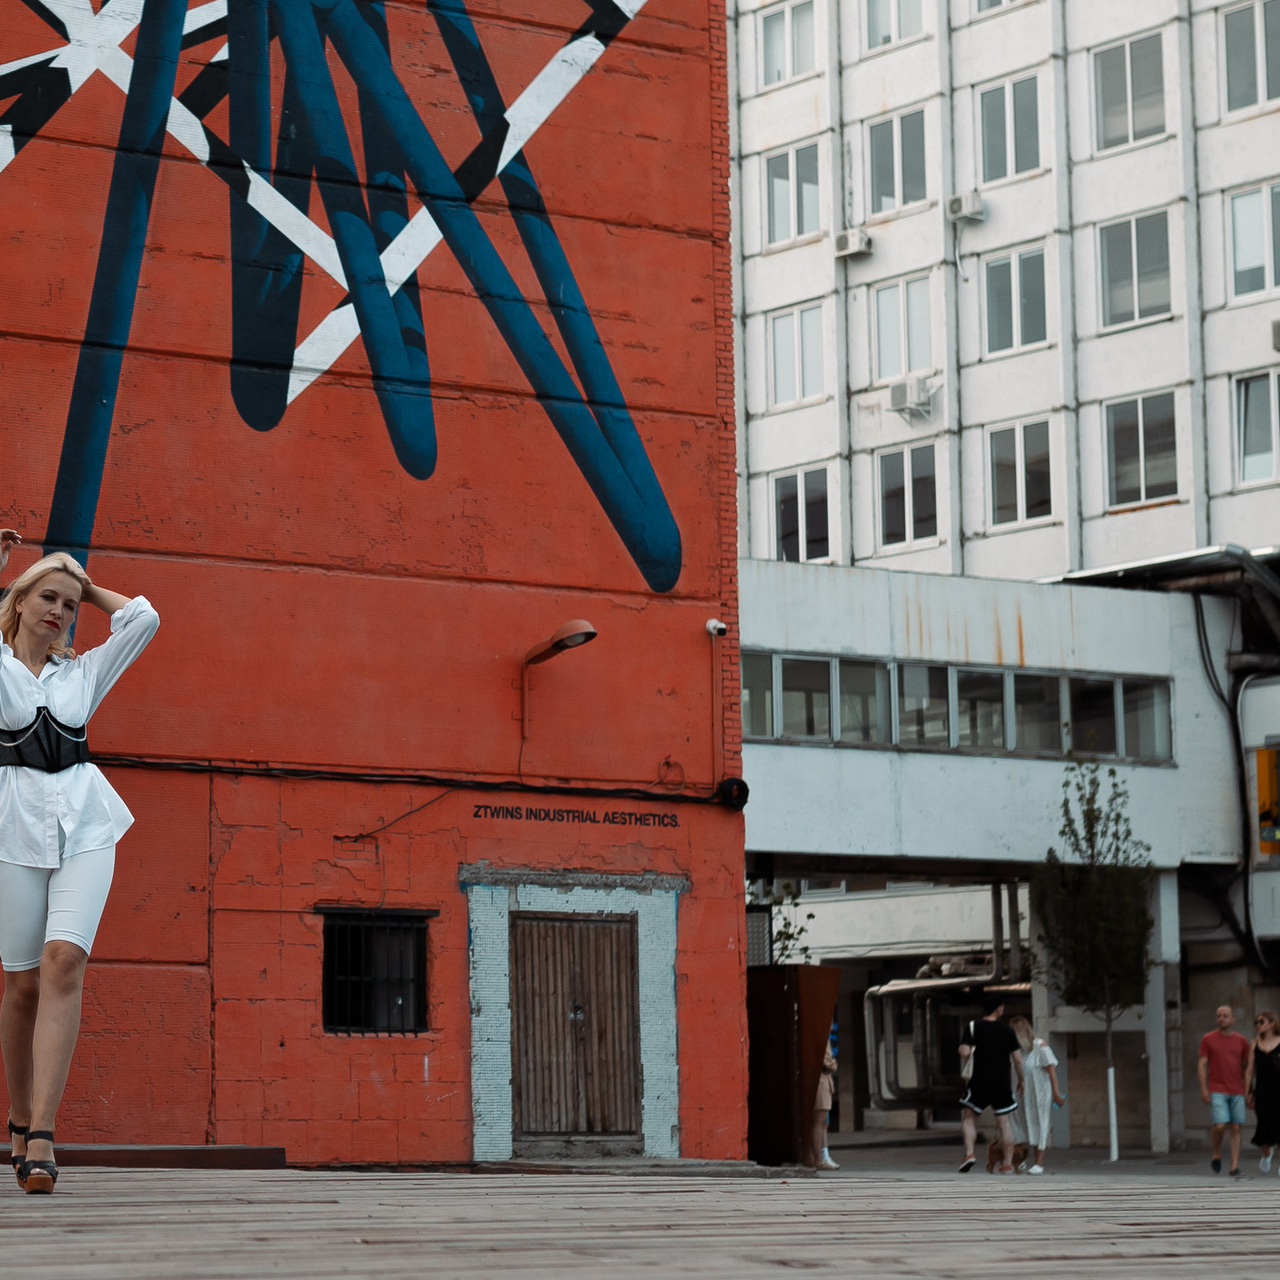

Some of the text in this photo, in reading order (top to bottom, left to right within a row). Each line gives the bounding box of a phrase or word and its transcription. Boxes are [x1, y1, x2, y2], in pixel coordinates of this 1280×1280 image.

[473, 805, 680, 827] ZTWINS INDUSTRIAL AESTHETICS.
